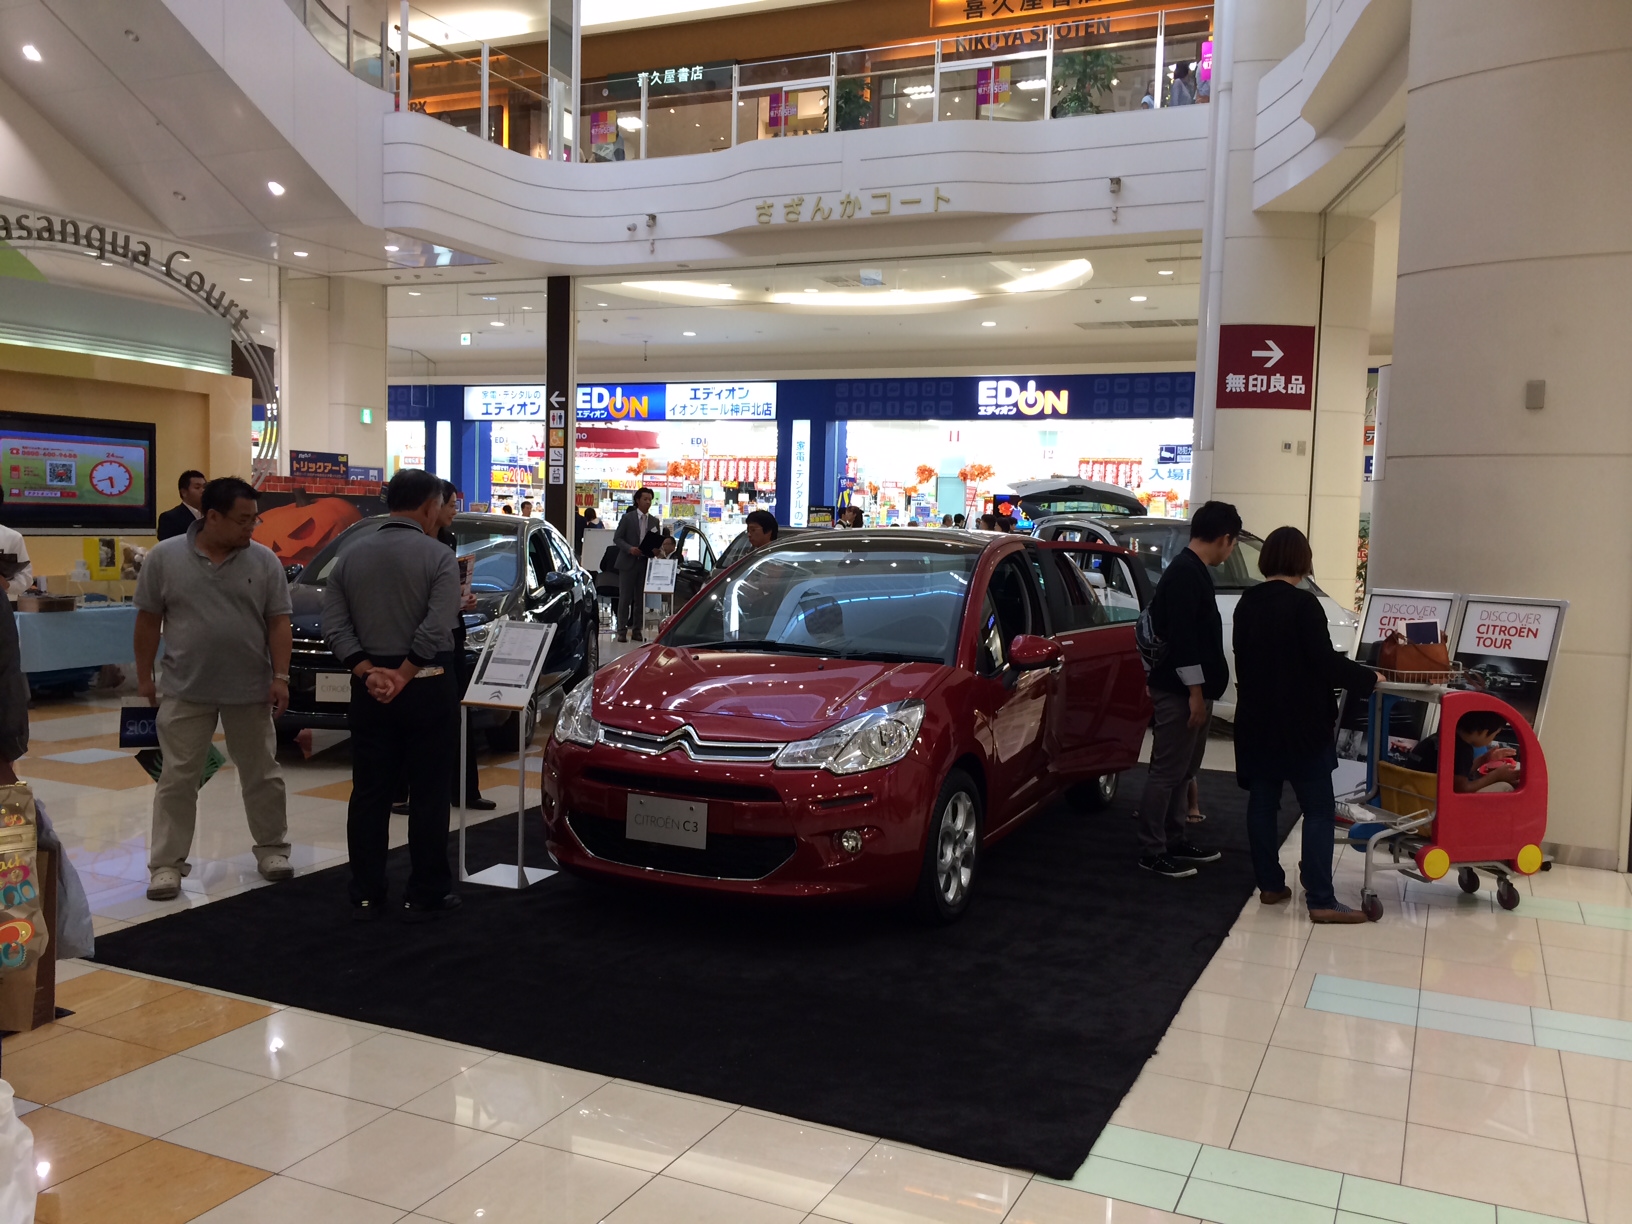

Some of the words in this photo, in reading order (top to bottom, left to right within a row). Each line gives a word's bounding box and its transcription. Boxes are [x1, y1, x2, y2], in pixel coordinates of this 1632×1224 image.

[756, 187, 950, 224] さざんかコート
[165, 251, 249, 331] Court
[1225, 373, 1305, 394] 無印良品
[689, 387, 750, 401] エディオン
[978, 380, 1069, 416] EDION
[669, 402, 772, 417] イオンモール神戸北店
[293, 460, 346, 474] トリックアート
[1382, 603, 1437, 617] DISCOVER
[1479, 610, 1541, 625] DISCOVER
[1476, 623, 1539, 639] CITROËN
[1475, 636, 1512, 650] TOUR
[634, 811, 680, 831] CITROËN
[682, 820, 699, 833] C3
